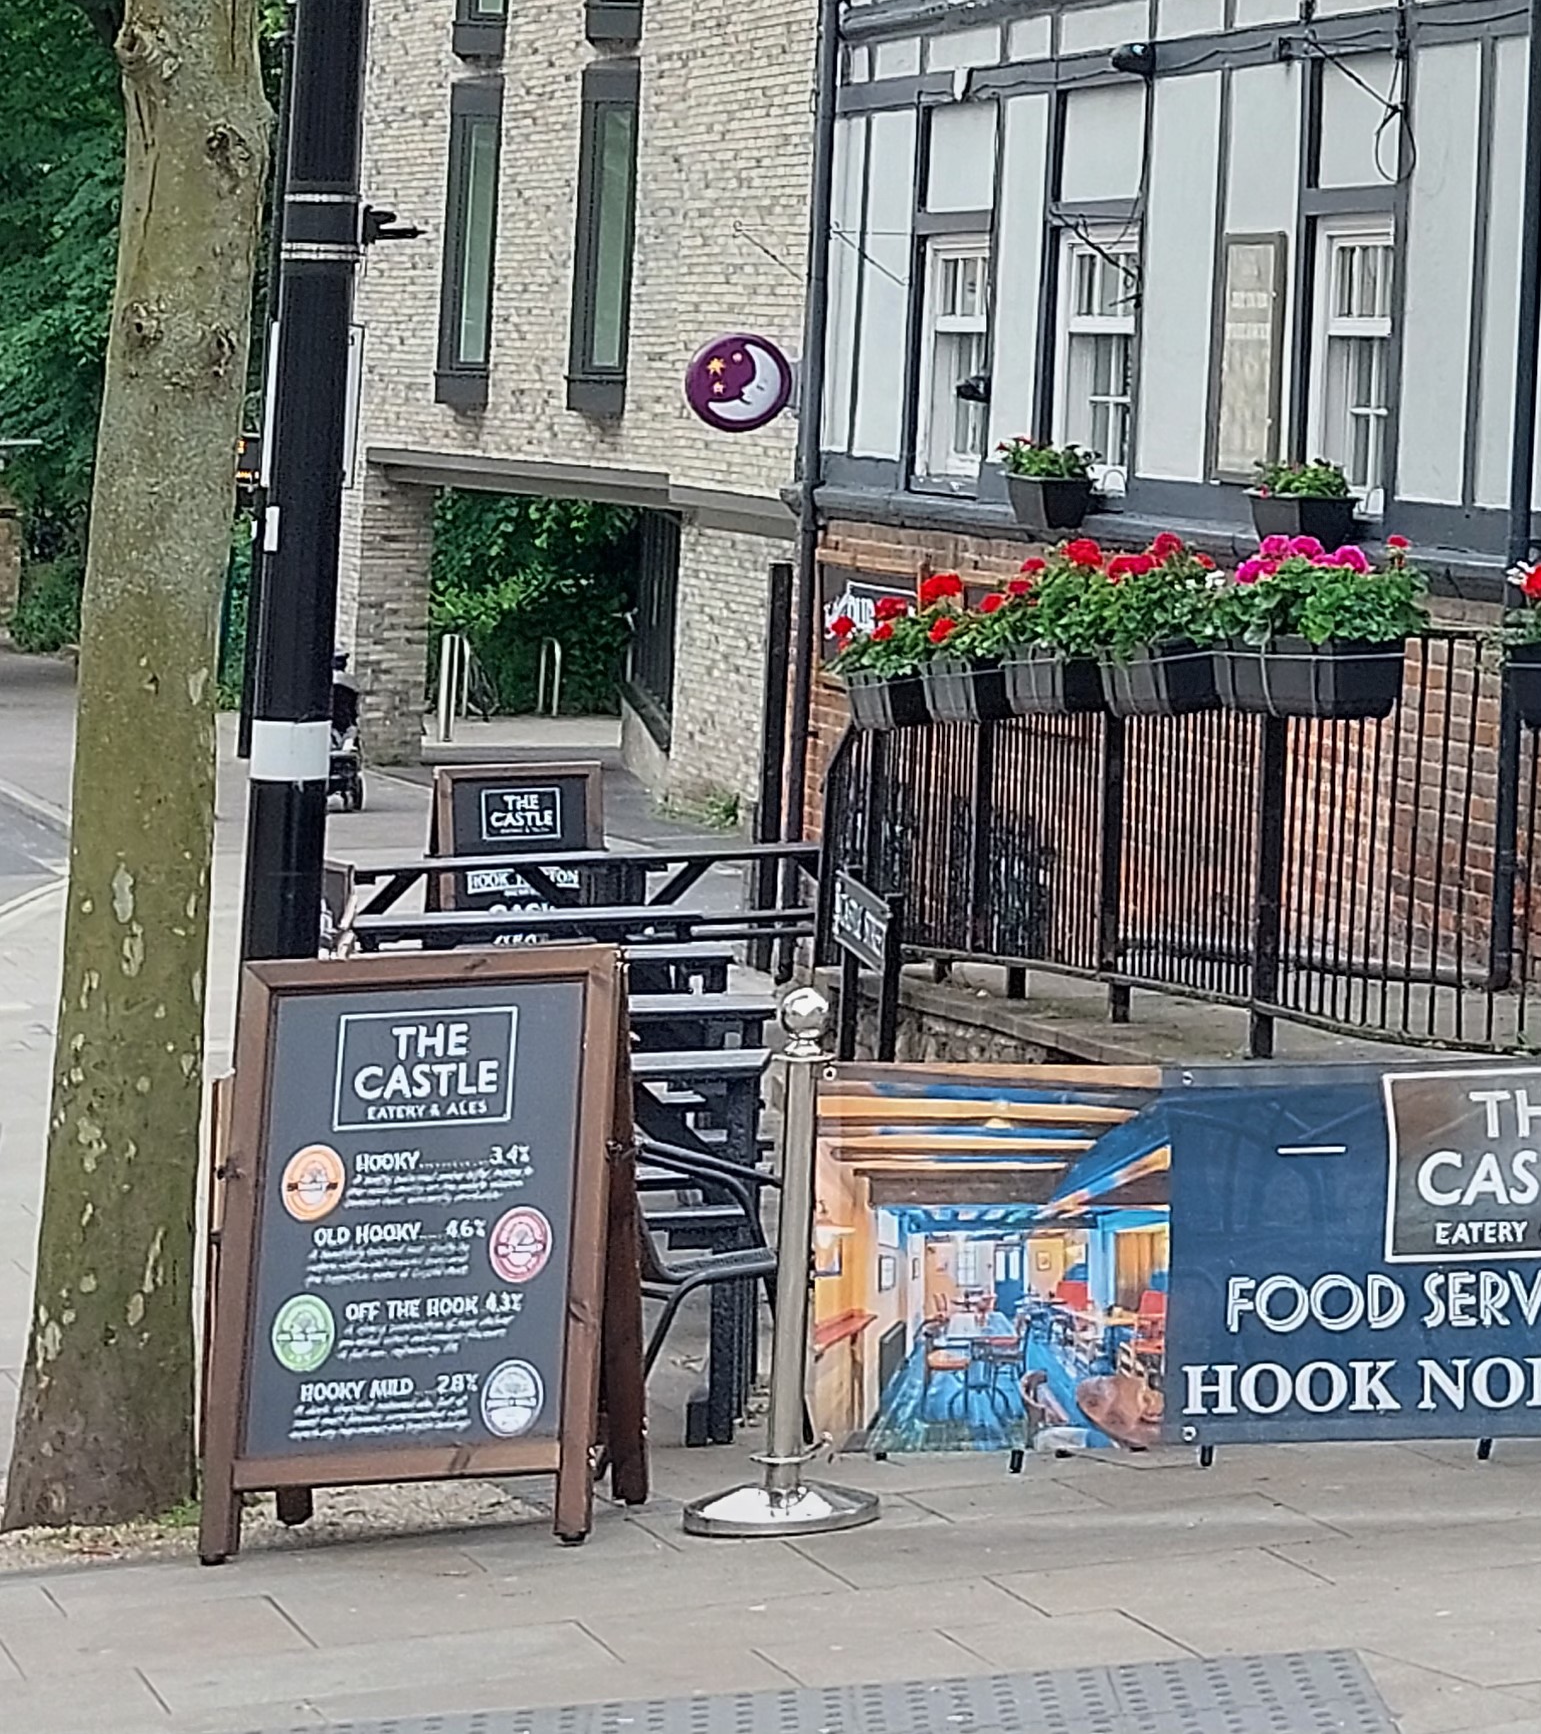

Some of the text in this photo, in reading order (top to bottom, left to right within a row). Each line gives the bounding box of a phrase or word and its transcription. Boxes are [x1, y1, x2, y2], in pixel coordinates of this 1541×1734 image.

[503, 794, 539, 810] THE
[490, 810, 553, 827] CASTLE
[392, 1022, 470, 1061] THE
[354, 1060, 499, 1100] CASTLE
[367, 1104, 427, 1121] EATERY
[446, 1099, 488, 1116] ALES
[355, 1150, 420, 1173] HOOKY
[313, 1226, 350, 1246] OLD
[355, 1220, 422, 1244] HOOKY
[1435, 1219, 1528, 1246] EATERY
[345, 1300, 381, 1321] OFF
[386, 1298, 421, 1319] THE
[427, 1295, 479, 1316] HOOK
[1225, 1272, 1406, 1334] FOOD
[301, 1379, 367, 1402] HOOKY
[369, 1376, 414, 1398] MILD
[1181, 1357, 1402, 1416] HOOK
